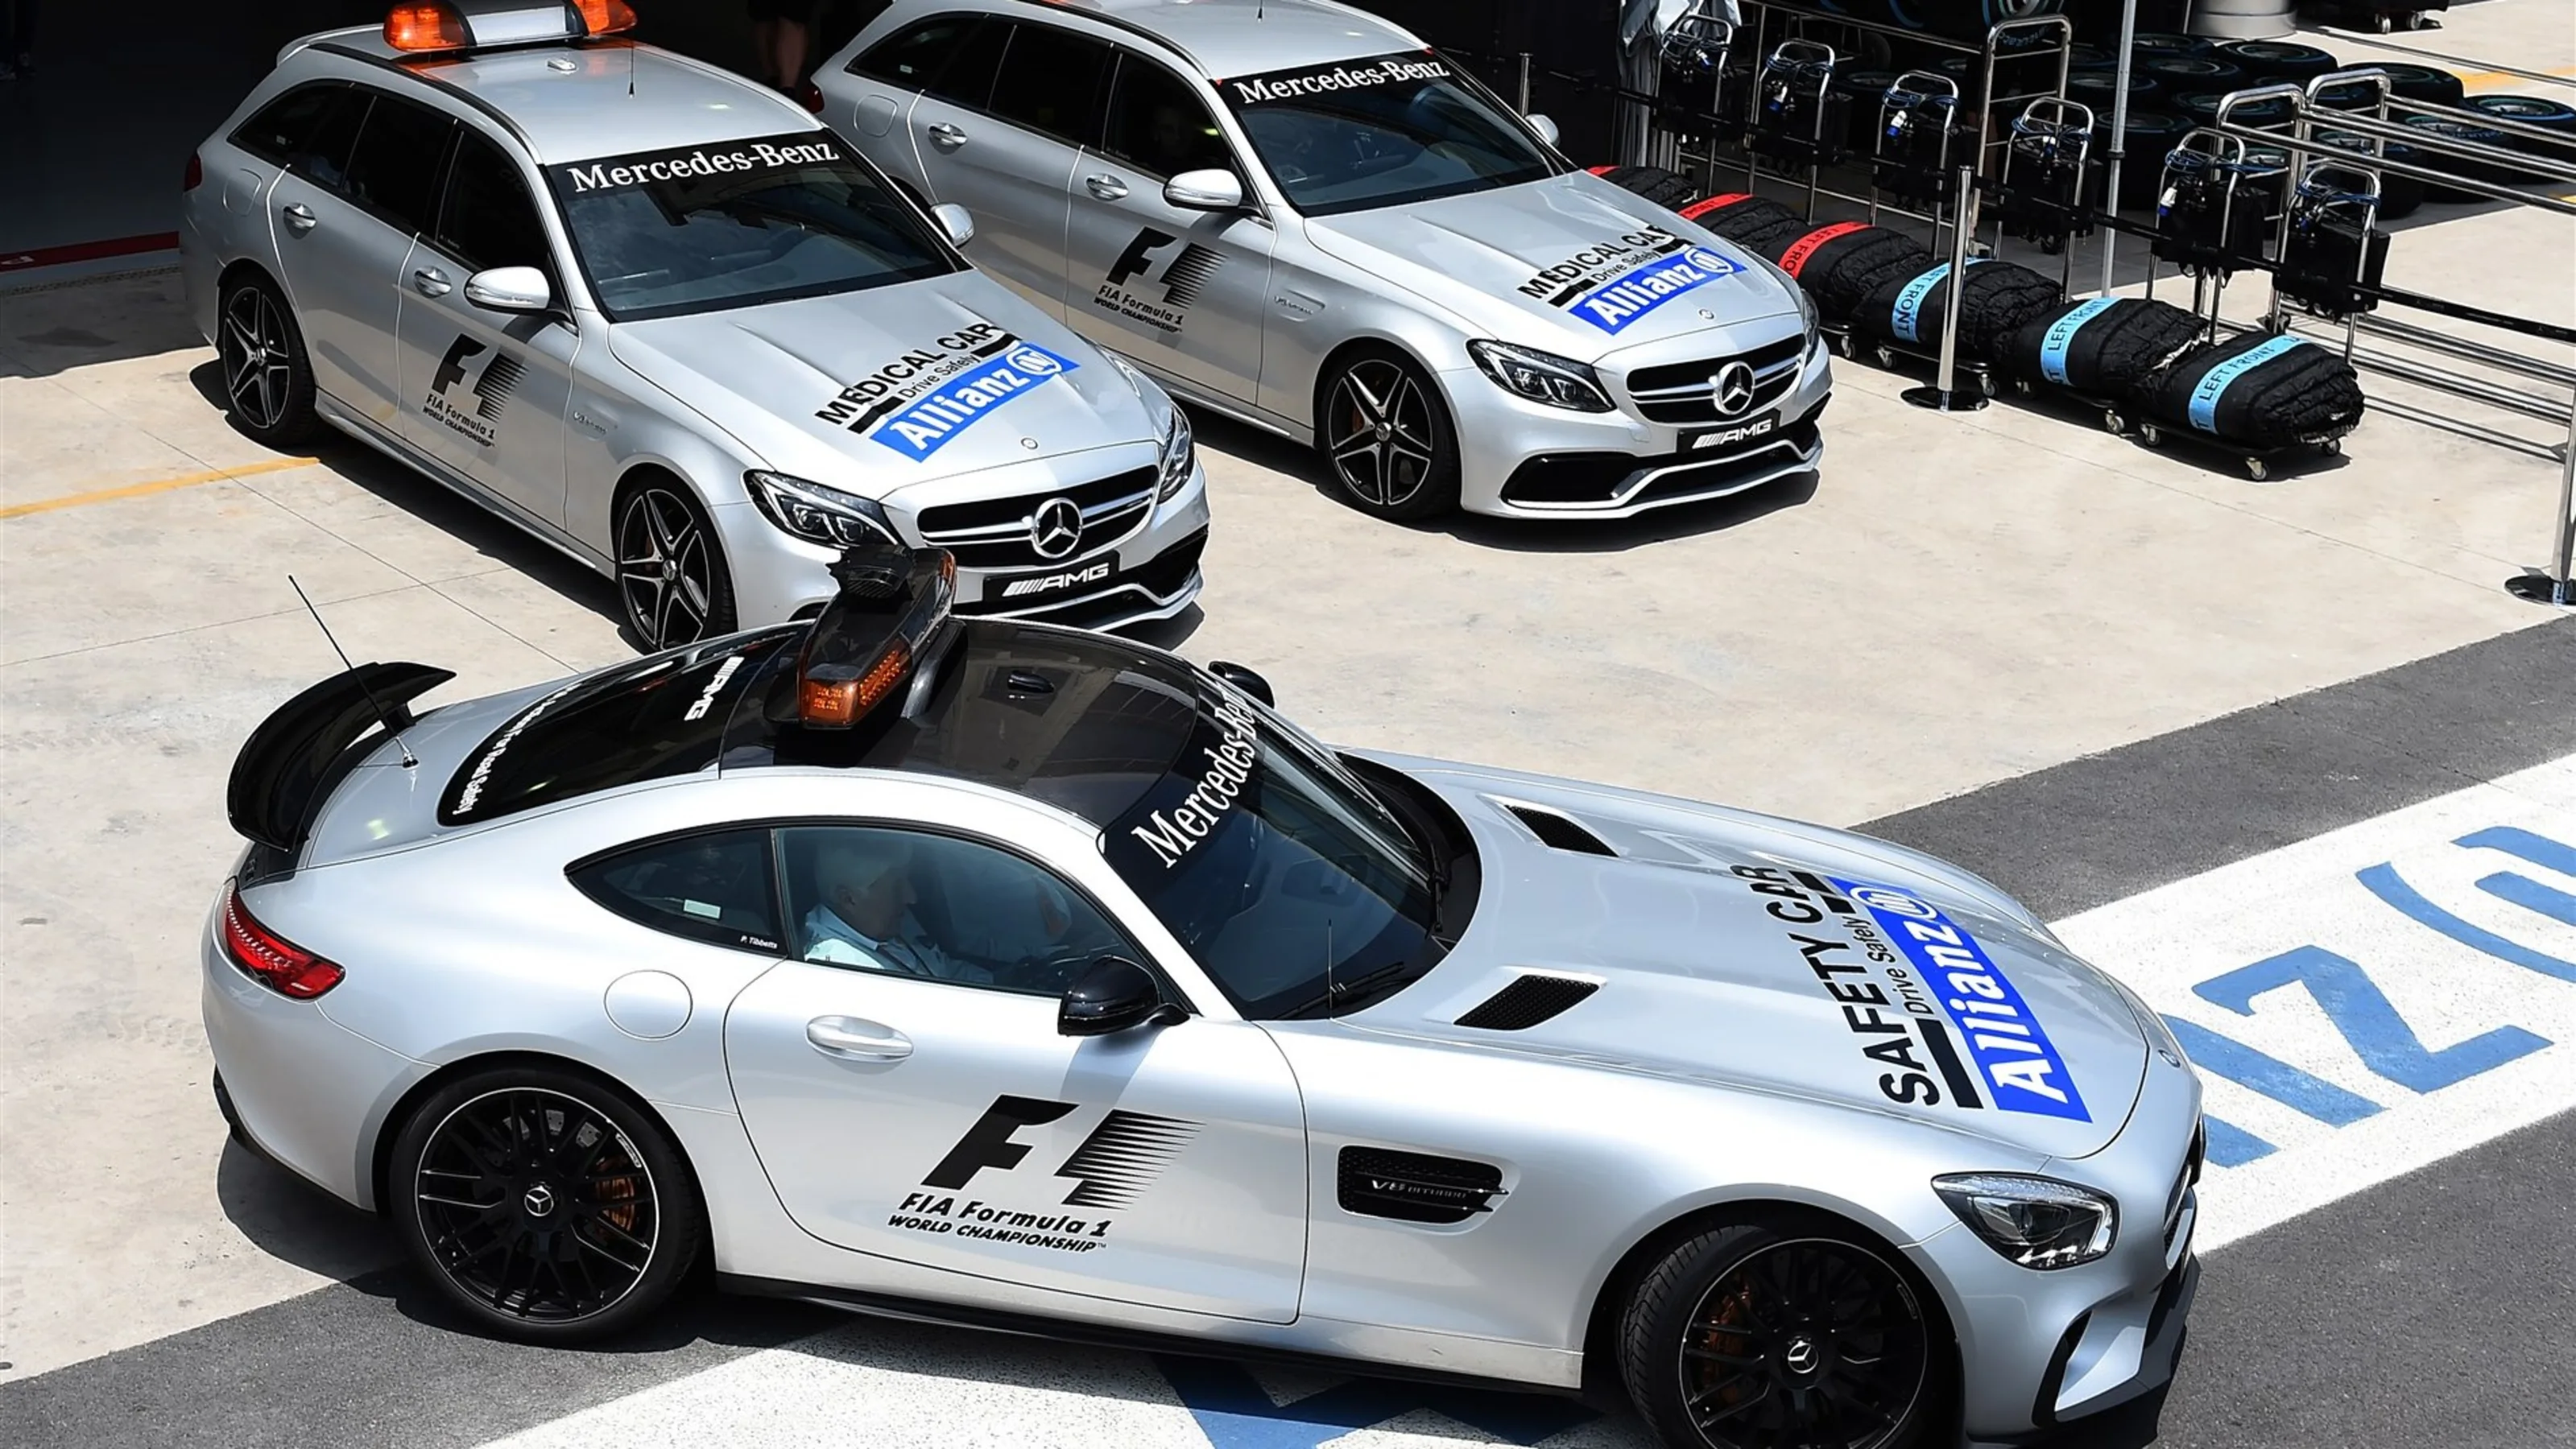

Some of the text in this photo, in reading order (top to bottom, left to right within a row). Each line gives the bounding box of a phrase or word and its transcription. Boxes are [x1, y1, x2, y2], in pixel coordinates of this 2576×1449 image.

[1233, 60, 1451, 104] Mercedes-Benz
[567, 142, 840, 192] Mercedes-Benz
[1104, 225, 1230, 310] F1
[1517, 242, 1633, 299] MEDICAL
[1591, 262, 1627, 283] Drive
[1784, 245, 1809, 274] FRO
[1093, 296, 1121, 312] WORLD
[1098, 284, 1185, 325] FIA Formula 1
[1585, 262, 1707, 326] Allianz
[1894, 283, 1926, 334] FRONT
[2047, 321, 2073, 351] LEFT
[431, 332, 530, 423] F1
[813, 349, 948, 425] MEDICAL
[898, 374, 941, 399] Drive
[2198, 346, 2276, 401] LEFT FRONT
[422, 405, 444, 424] WORLD
[426, 393, 495, 440] FIA Formula 1
[888, 368, 1031, 451] Allianz
[1721, 419, 1772, 445] AMG
[1040, 563, 1110, 592] AMG
[683, 671, 731, 722] AMG
[1729, 864, 1941, 1107] SAFETY CAR
[1887, 967, 1934, 1015] Drive
[1904, 919, 2069, 1105] Allianz
[920, 1092, 1207, 1212] F1
[887, 1214, 953, 1234] WORLD
[898, 1191, 1113, 1238] FIA Formula 1
